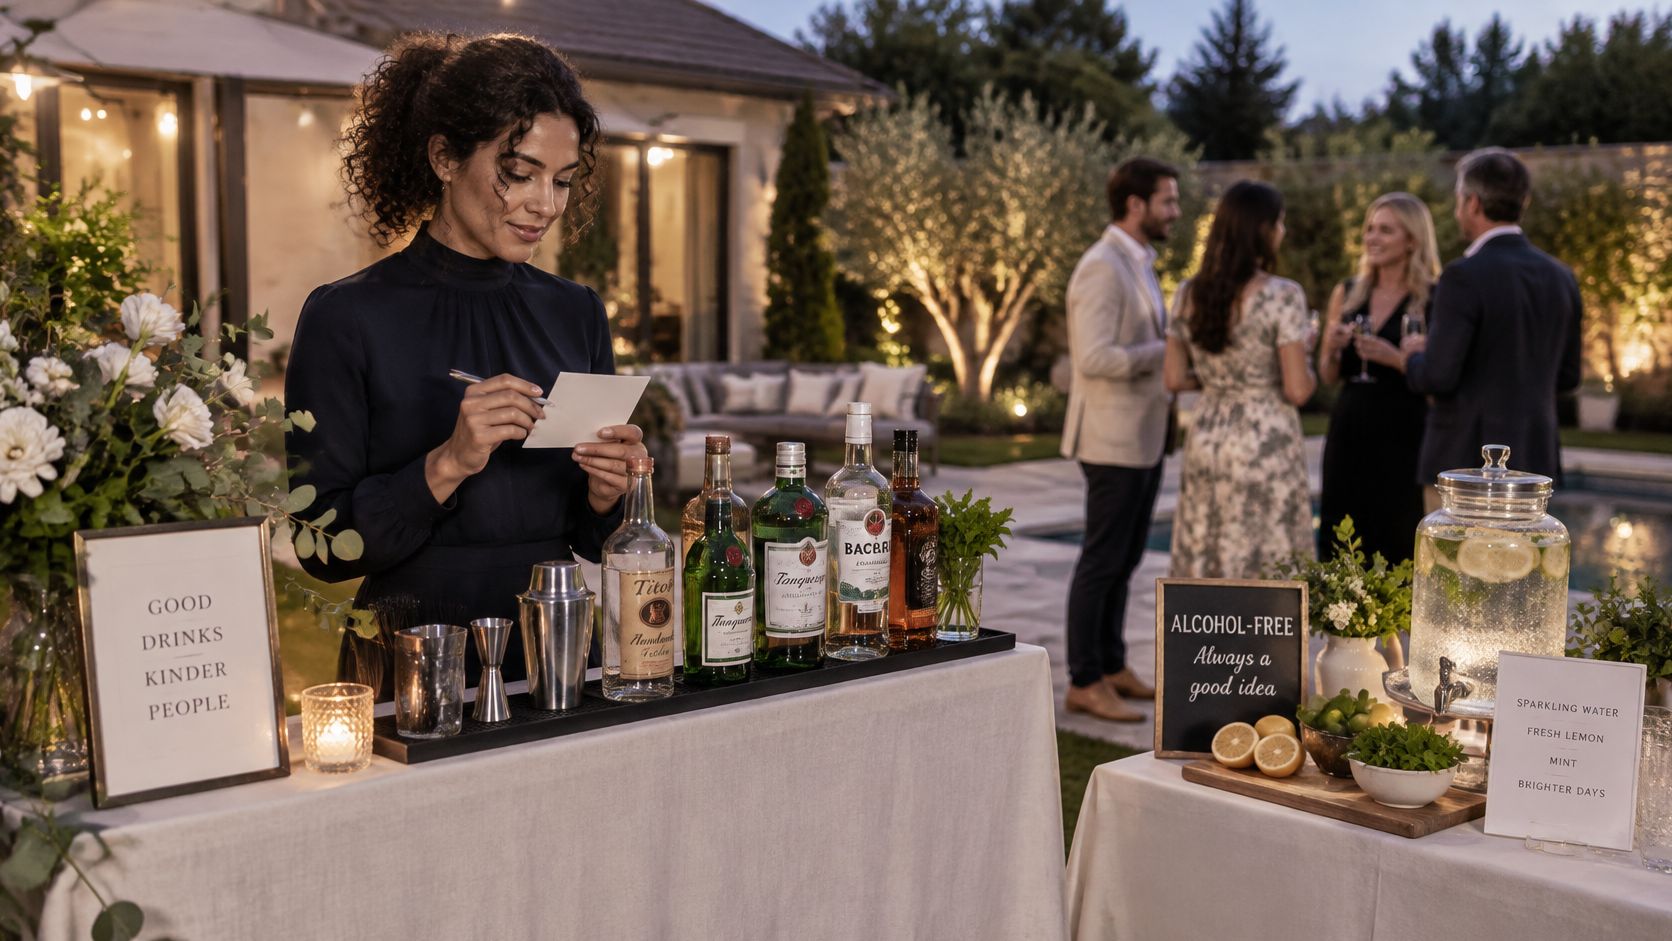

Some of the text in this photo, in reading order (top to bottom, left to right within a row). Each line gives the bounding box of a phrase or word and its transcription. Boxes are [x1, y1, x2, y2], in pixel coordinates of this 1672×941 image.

[147, 594, 212, 615] GOOD
[1170, 614, 1294, 637] ALCOHOL-FREE
[142, 626, 223, 651] DRINKS
[1193, 645, 1272, 674] Always a
[145, 661, 227, 687] KINDER
[1188, 675, 1277, 703] good idea
[148, 694, 230, 721] PEOPLE
[1516, 698, 1619, 718] SPARKLING WATER
[1527, 726, 1604, 744] FRESH LEMON
[1549, 756, 1578, 768] MINT
[1518, 779, 1606, 798] BRIGHTER DAYS
